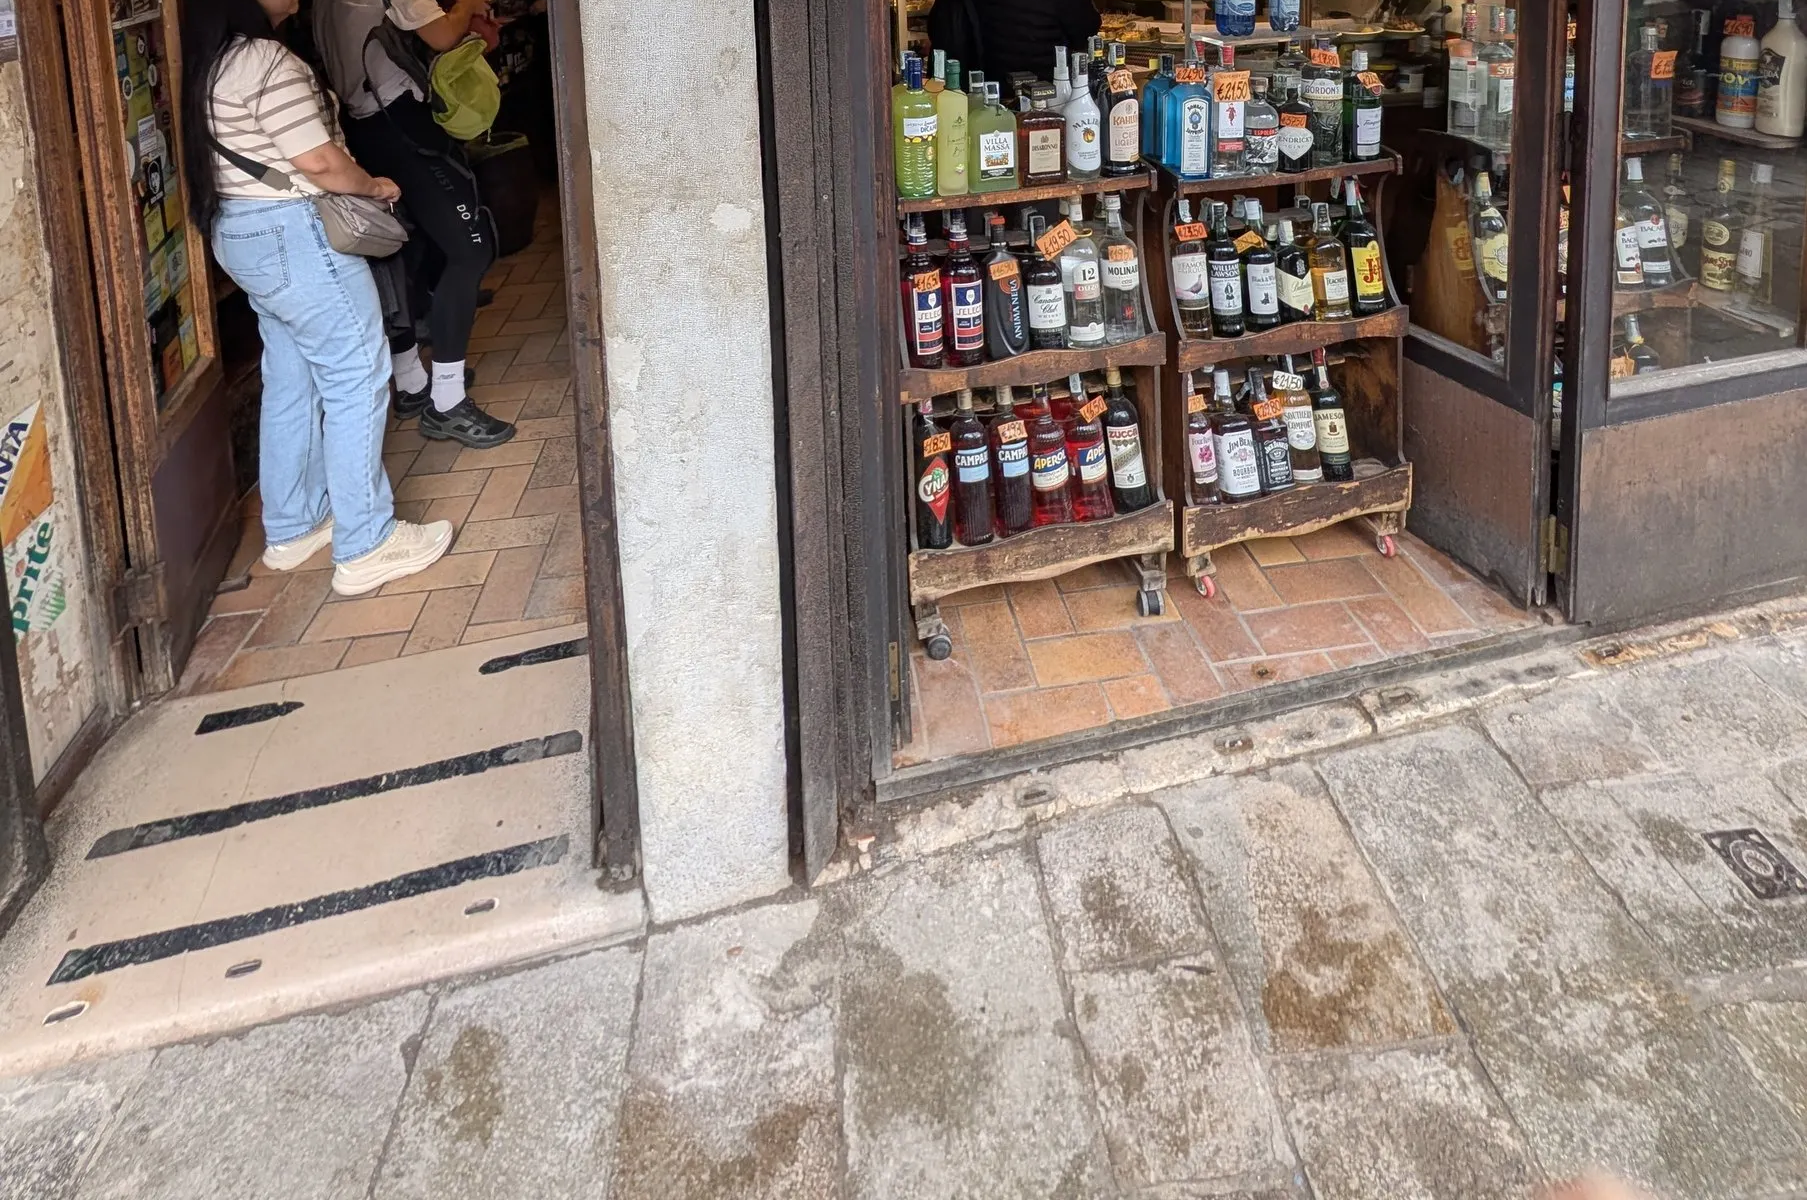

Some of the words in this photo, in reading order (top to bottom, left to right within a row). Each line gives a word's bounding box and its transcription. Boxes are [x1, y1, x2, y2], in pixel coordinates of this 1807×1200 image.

[983, 144, 1010, 152] MASSA
[985, 137, 1008, 145] VILLA
[456, 204, 471, 220] DO
[471, 233, 482, 243] IT
[1081, 267, 1096, 282] 12
[1034, 449, 1067, 470] APEROL
[12, 522, 54, 640] prite
